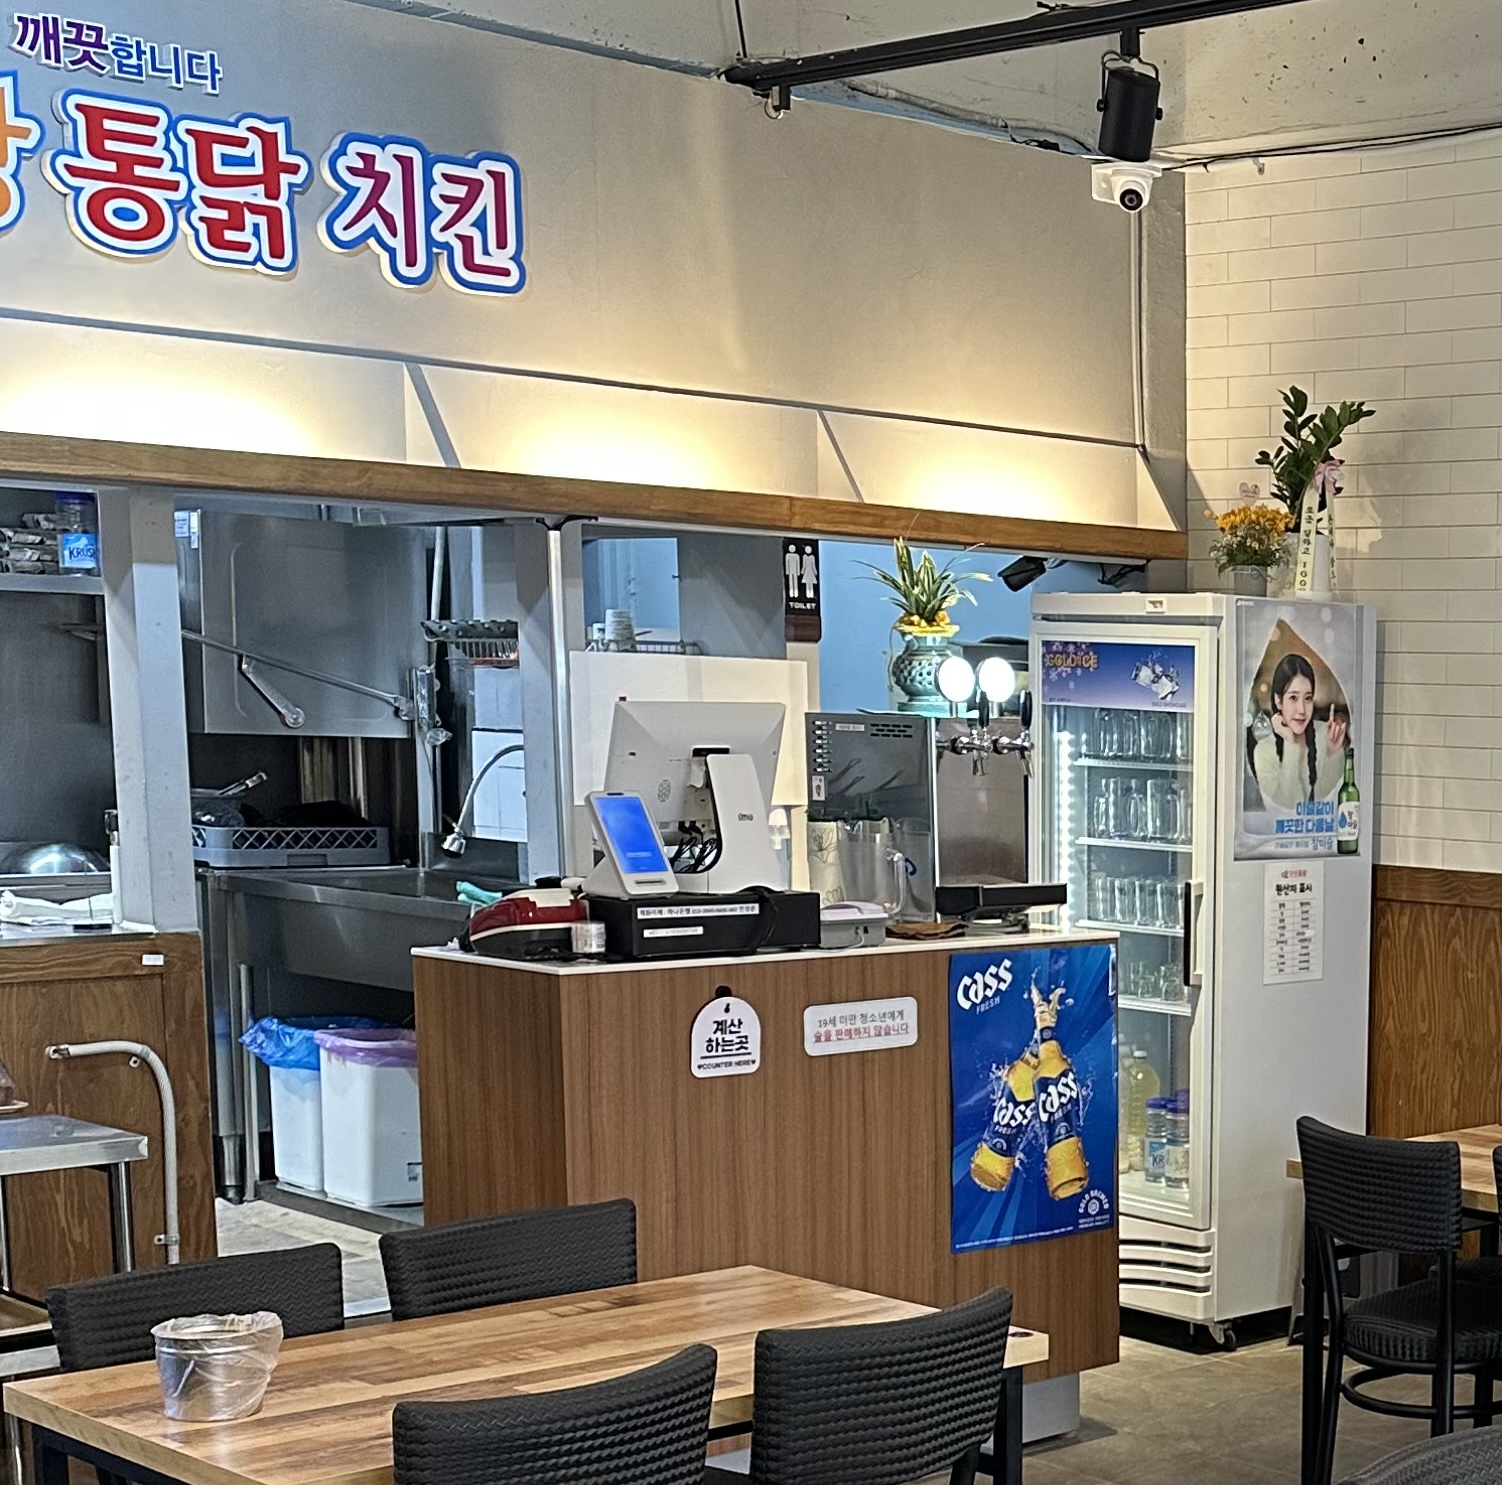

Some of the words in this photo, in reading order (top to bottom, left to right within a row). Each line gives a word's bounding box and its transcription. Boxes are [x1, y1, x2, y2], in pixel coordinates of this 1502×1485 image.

[13, 12, 222, 93] 깨끗합니다
[54, 96, 307, 268] 통닭
[331, 140, 518, 286] 치킨
[68, 546, 97, 561] KRUS
[788, 601, 817, 610] TOILET
[975, 995, 1001, 1015] FRESH
[712, 1018, 743, 1035] 계산
[839, 1013, 857, 1026] 미만
[859, 1009, 904, 1025] 청소년에게
[835, 1025, 871, 1041] 판매하지
[873, 1022, 909, 1037] 않습니다
[705, 1034, 749, 1053] 하는곳
